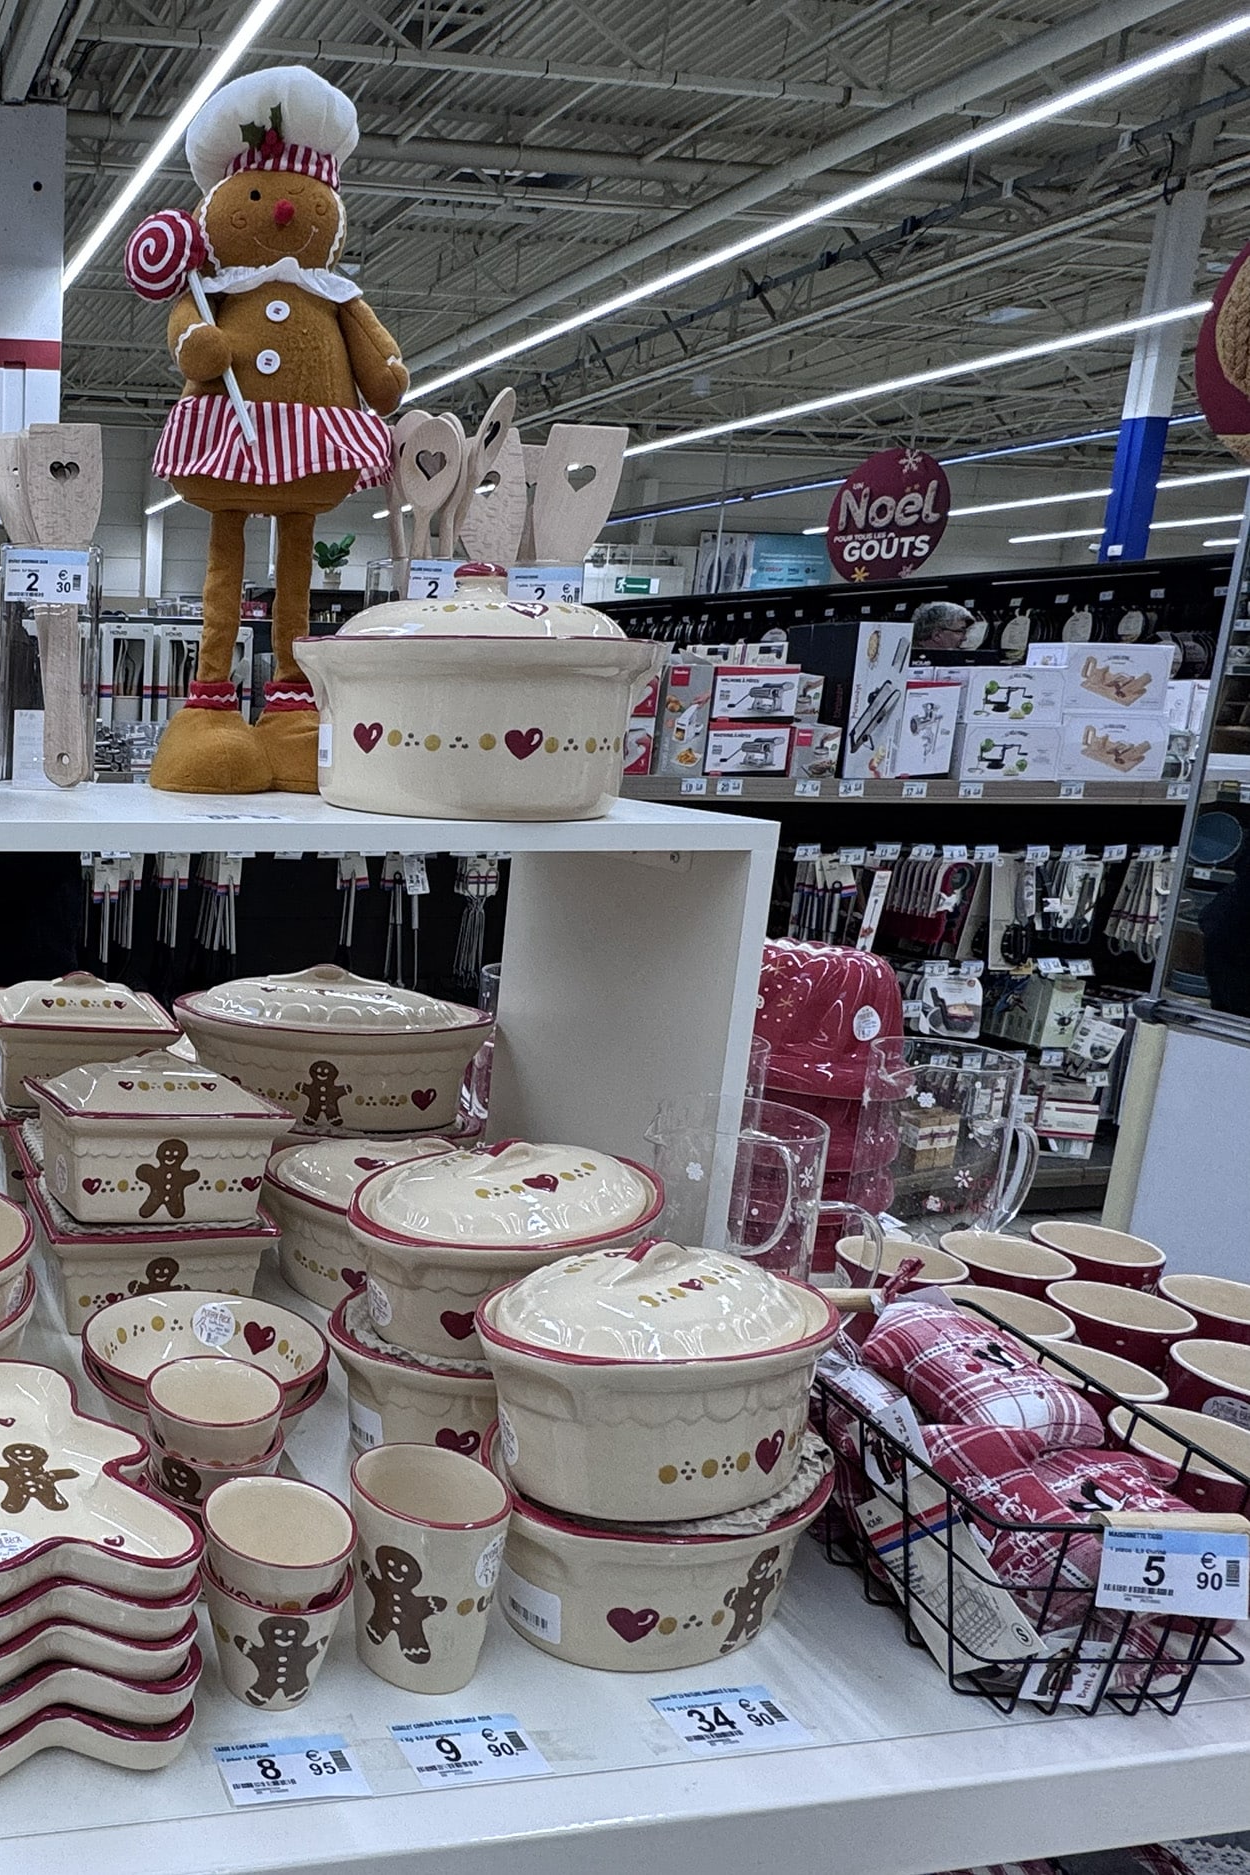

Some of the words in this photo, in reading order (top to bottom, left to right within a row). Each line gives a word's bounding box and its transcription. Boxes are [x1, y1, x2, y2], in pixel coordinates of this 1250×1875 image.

[852, 482, 864, 490] UN
[838, 480, 941, 531] Noël
[834, 533, 853, 543] POUR
[854, 532, 872, 541] TOUS
[873, 531, 887, 540] LES
[843, 532, 930, 562] GOÛTS
[58, 569, 69, 581] €
[26, 573, 39, 592] 2
[56, 582, 71, 593] 30
[427, 581, 439, 599] 2
[534, 588, 546, 600] 2
[1201, 1552, 1217, 1570] €
[1142, 1556, 1165, 1587] 5
[1197, 1572, 1223, 1591] 90
[739, 1698, 756, 1712] €
[687, 1706, 737, 1733] 34
[747, 1713, 774, 1727] 90
[482, 1728, 498, 1742] €
[305, 1749, 322, 1762] €
[435, 1737, 462, 1763] 9
[487, 1743, 514, 1757] 90
[257, 1758, 282, 1781] 8
[309, 1762, 336, 1776] 95
